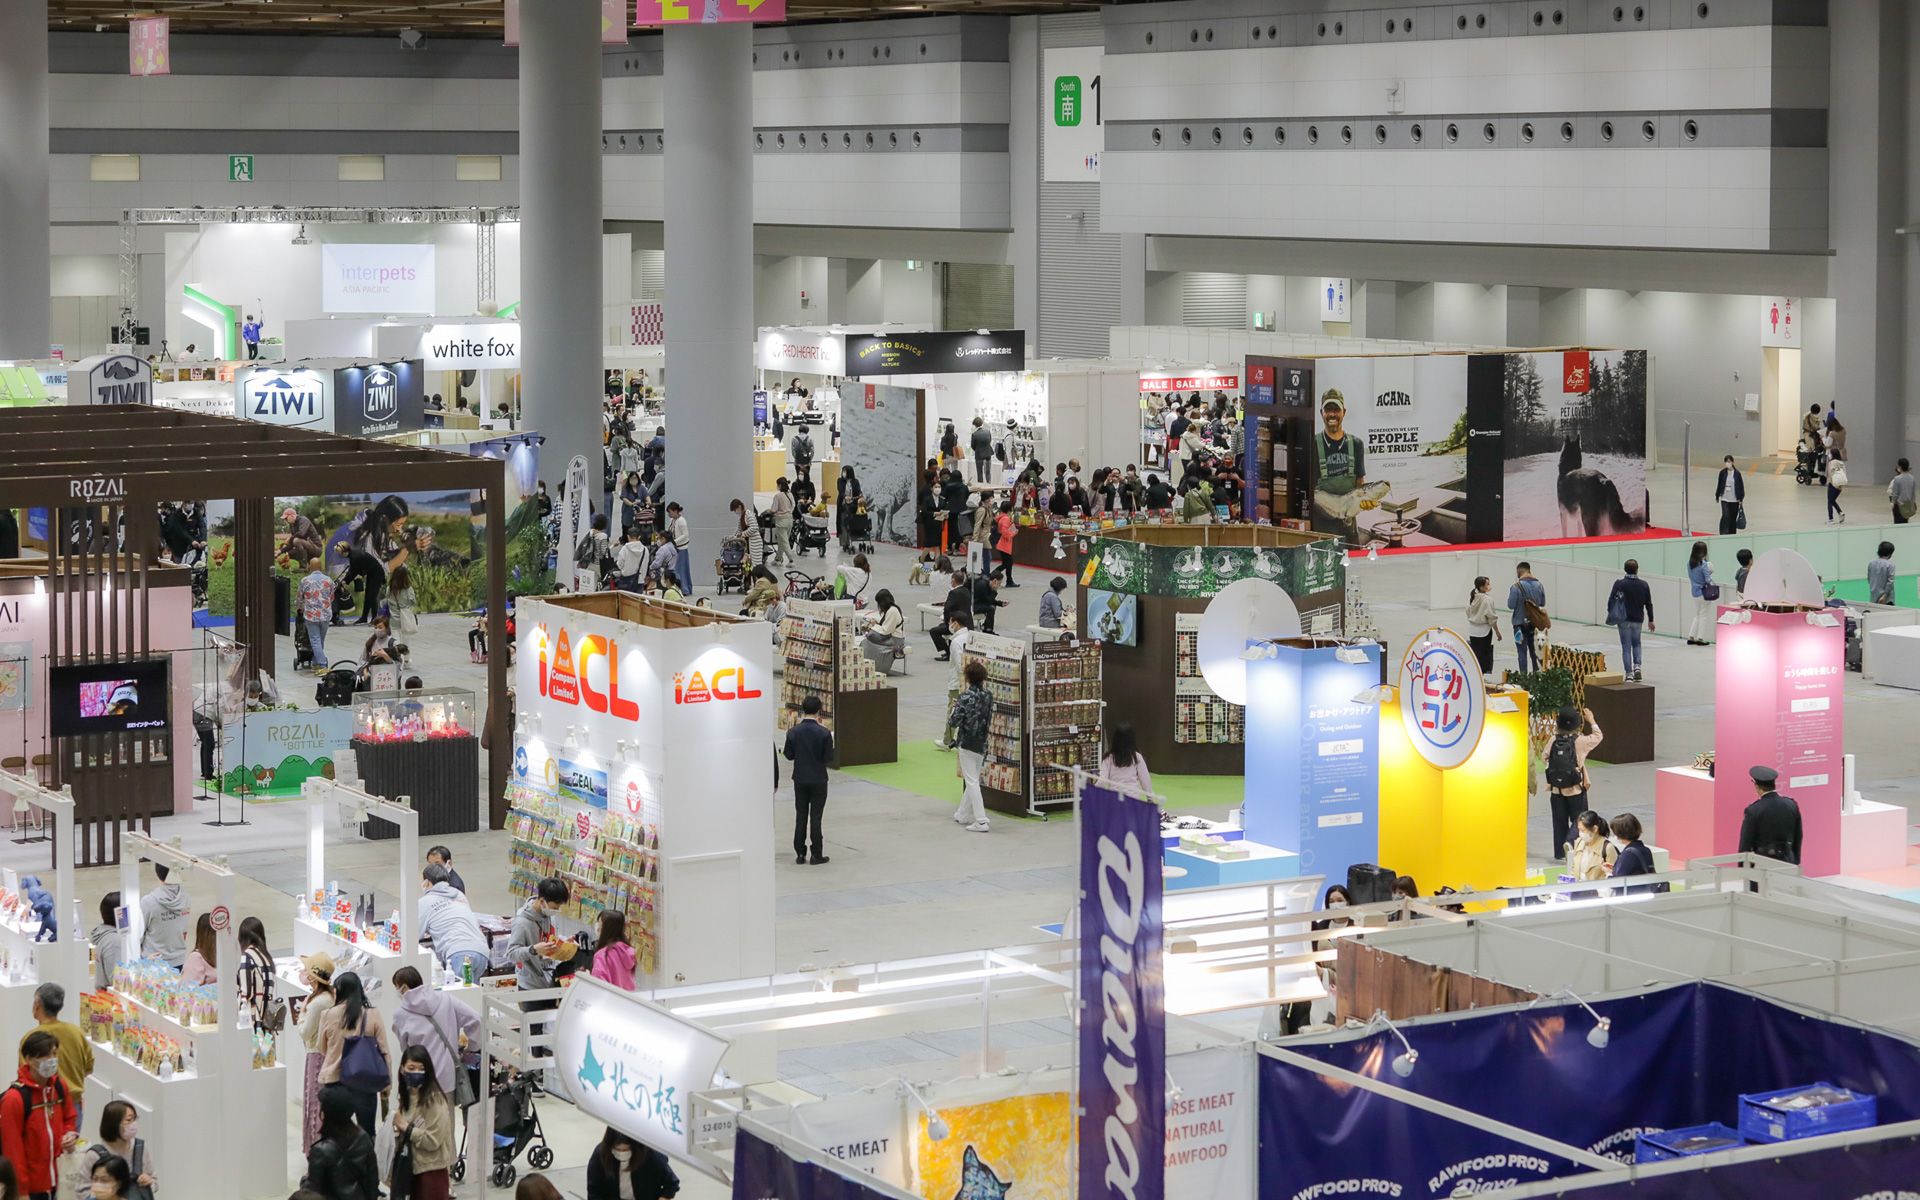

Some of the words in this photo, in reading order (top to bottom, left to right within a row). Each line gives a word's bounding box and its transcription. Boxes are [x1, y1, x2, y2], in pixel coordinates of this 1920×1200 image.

[1060, 82, 1076, 92] South
[1062, 94, 1074, 122] 南
[1090, 75, 1100, 126] 1
[342, 264, 416, 284] interpets
[362, 286, 390, 294] PACIFIC
[433, 340, 484, 358] white
[488, 336, 514, 356] fox
[860, 344, 880, 358] BACK
[894, 342, 922, 357] BASICS
[965, 348, 1012, 356] レッドハート株式会社
[1142, 381, 1168, 390] SALE
[1176, 380, 1202, 389] SALE
[1209, 378, 1234, 387] SALE
[98, 381, 147, 404] ZIWI
[368, 384, 395, 412] ZIWI
[1376, 390, 1412, 407] ACANA
[254, 392, 314, 415] ZIWI
[1561, 407, 1571, 417] PET
[1369, 432, 1418, 444] PEOPLE
[1369, 446, 1385, 454] WE
[1387, 444, 1419, 453] TRUST
[573, 468, 586, 489] ZIWI
[70, 478, 123, 497] ROZAI
[560, 640, 568, 652] Ito
[1420, 642, 1442, 654] Sparkling
[1443, 642, 1466, 666] Collection
[558, 656, 570, 668] And
[1412, 660, 1421, 673] IP
[551, 669, 576, 687] Company
[1784, 666, 1838, 678] おうち時間を楽しむ
[552, 684, 576, 700] Limited.
[1309, 705, 1374, 719] お出かけ・アウトドア
[268, 724, 319, 742] ROZAI
[1320, 726, 1335, 734] Outing
[572, 772, 596, 794] ZEAL
[610, 1061, 682, 1135] 北の極
[1198, 1092, 1236, 1112] MEAT
[703, 1121, 732, 1132] S2-E010
[849, 1138, 889, 1159] MEAT
[1428, 1154, 1506, 1193] RAWFOOD
[1508, 1154, 1550, 1174] PRO'S
[1361, 1178, 1402, 1197] PRO'S
